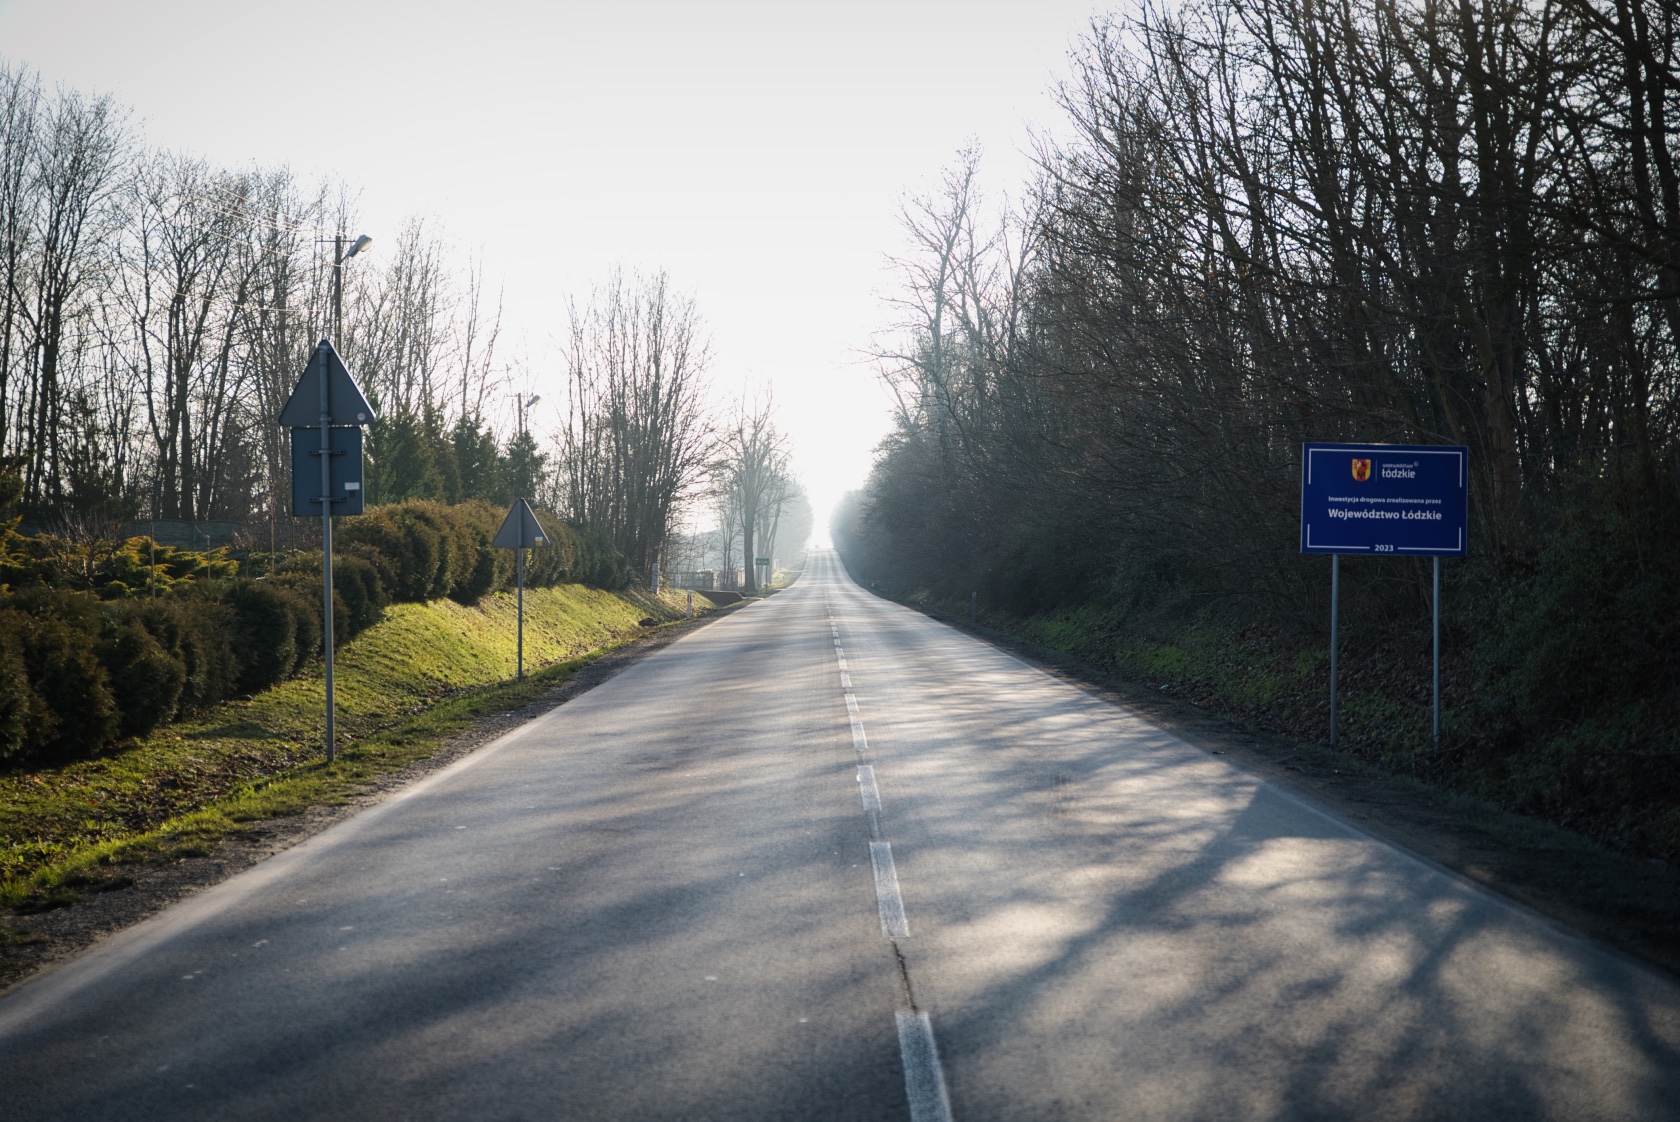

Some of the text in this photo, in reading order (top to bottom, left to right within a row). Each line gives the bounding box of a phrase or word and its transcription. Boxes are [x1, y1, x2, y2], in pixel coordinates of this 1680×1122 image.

[1328, 496, 1359, 504] Inwestycja
[1359, 496, 1386, 504] drogowa
[1328, 508, 1442, 520] Województwo Łódzkie
[1374, 544, 1394, 552] 2023
